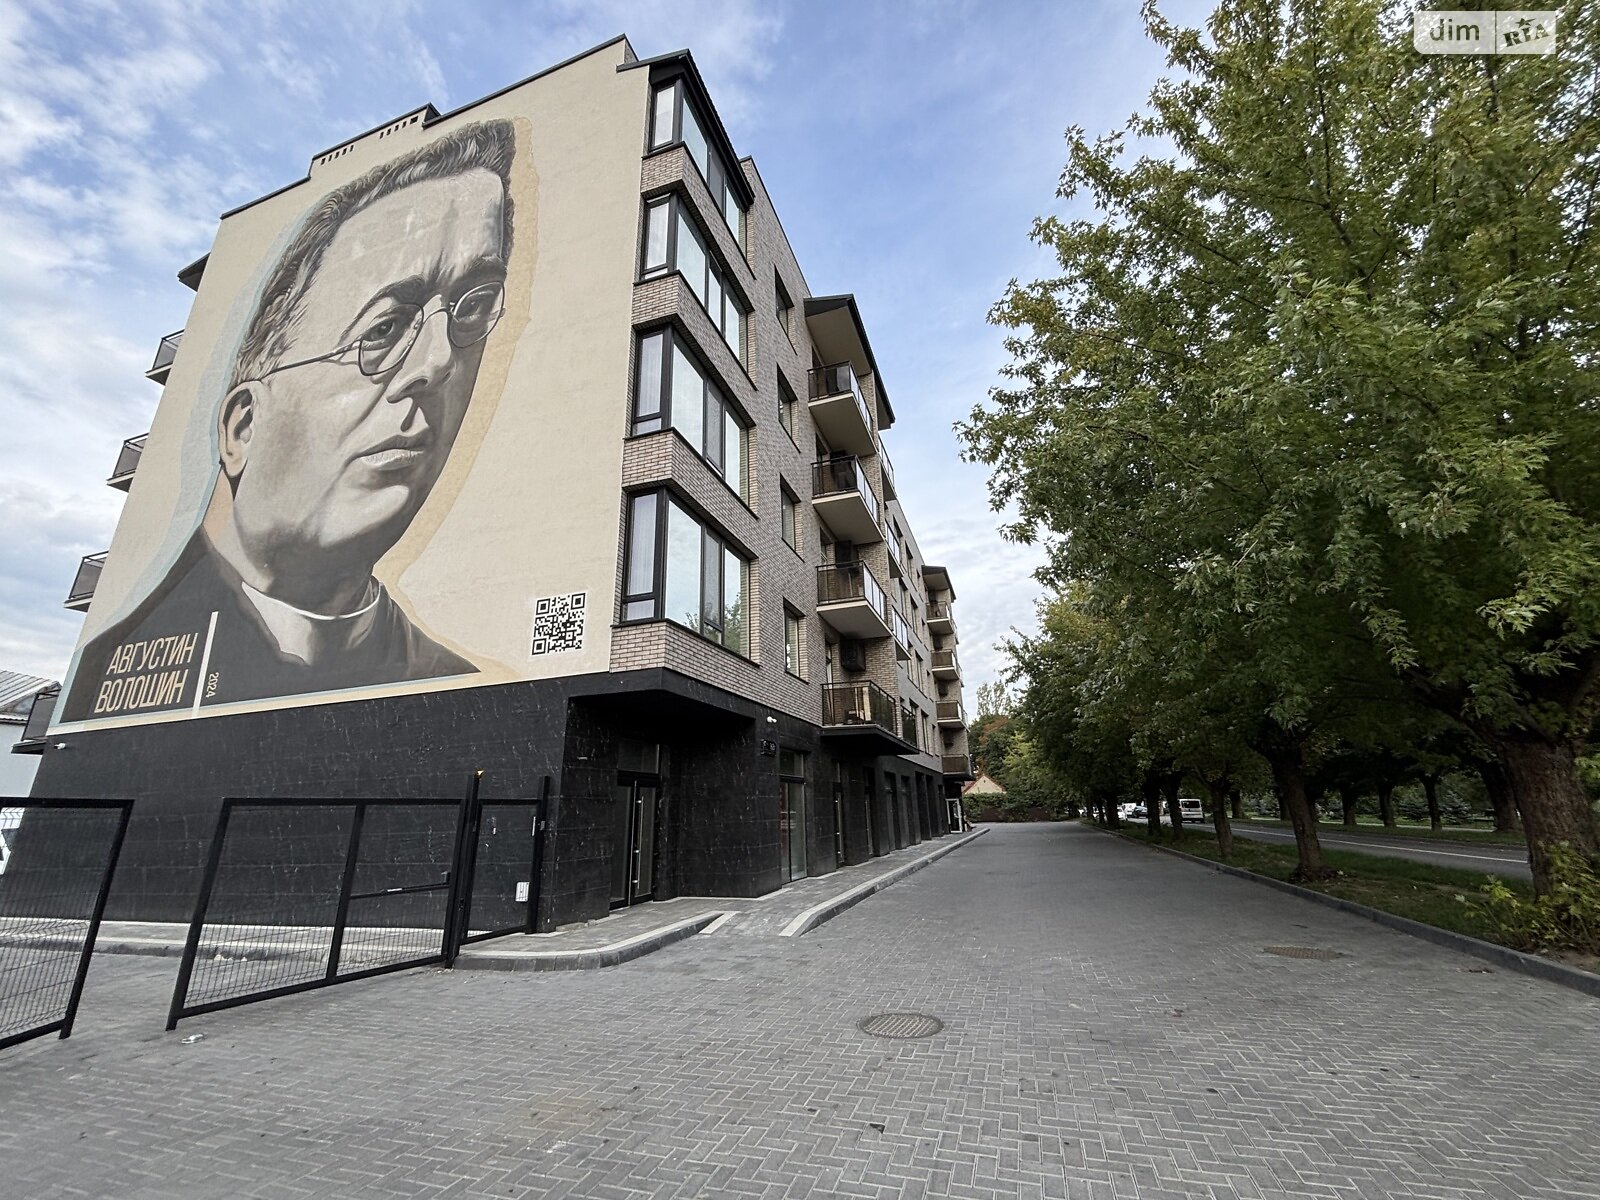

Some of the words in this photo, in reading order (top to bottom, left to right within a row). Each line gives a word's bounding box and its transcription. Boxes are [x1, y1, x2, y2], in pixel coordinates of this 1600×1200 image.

[106, 632, 198, 675] АВГУСТИН
[94, 669, 189, 714] ВОЛОШИН
[205, 672, 219, 698] 2024
